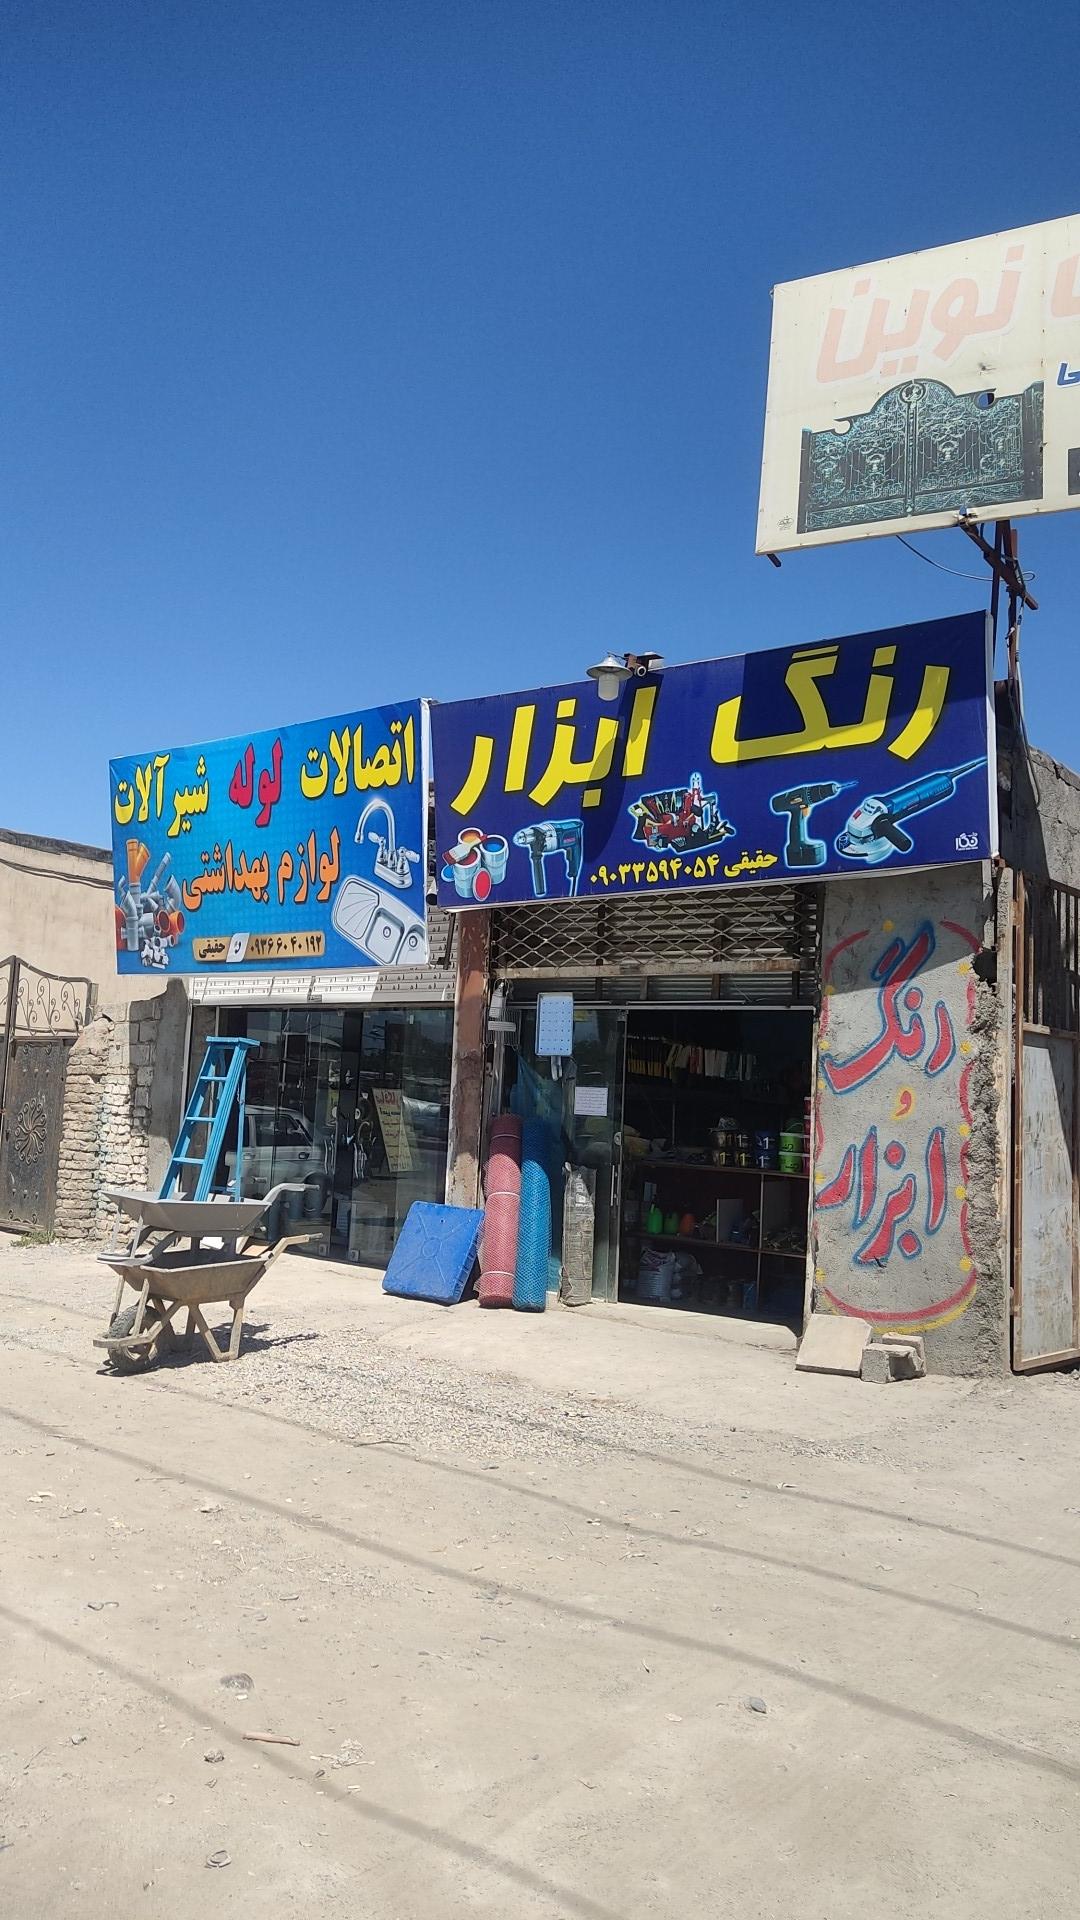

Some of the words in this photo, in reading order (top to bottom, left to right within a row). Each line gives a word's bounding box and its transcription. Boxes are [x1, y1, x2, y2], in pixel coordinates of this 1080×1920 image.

[817, 244, 1025, 383] نوین
[710, 645, 950, 764] رنگ
[228, 738, 283, 827] لوله
[300, 715, 415, 798] اتصالات
[450, 685, 658, 816] ابزار
[182, 839, 269, 910] بهداشتی
[277, 827, 340, 903] لوازم
[724, 850, 778, 877] حقیقی
[198, 939, 226, 958] حقیقی
[822, 919, 956, 1095] رنگ
[814, 1125, 946, 1267] ابزار
